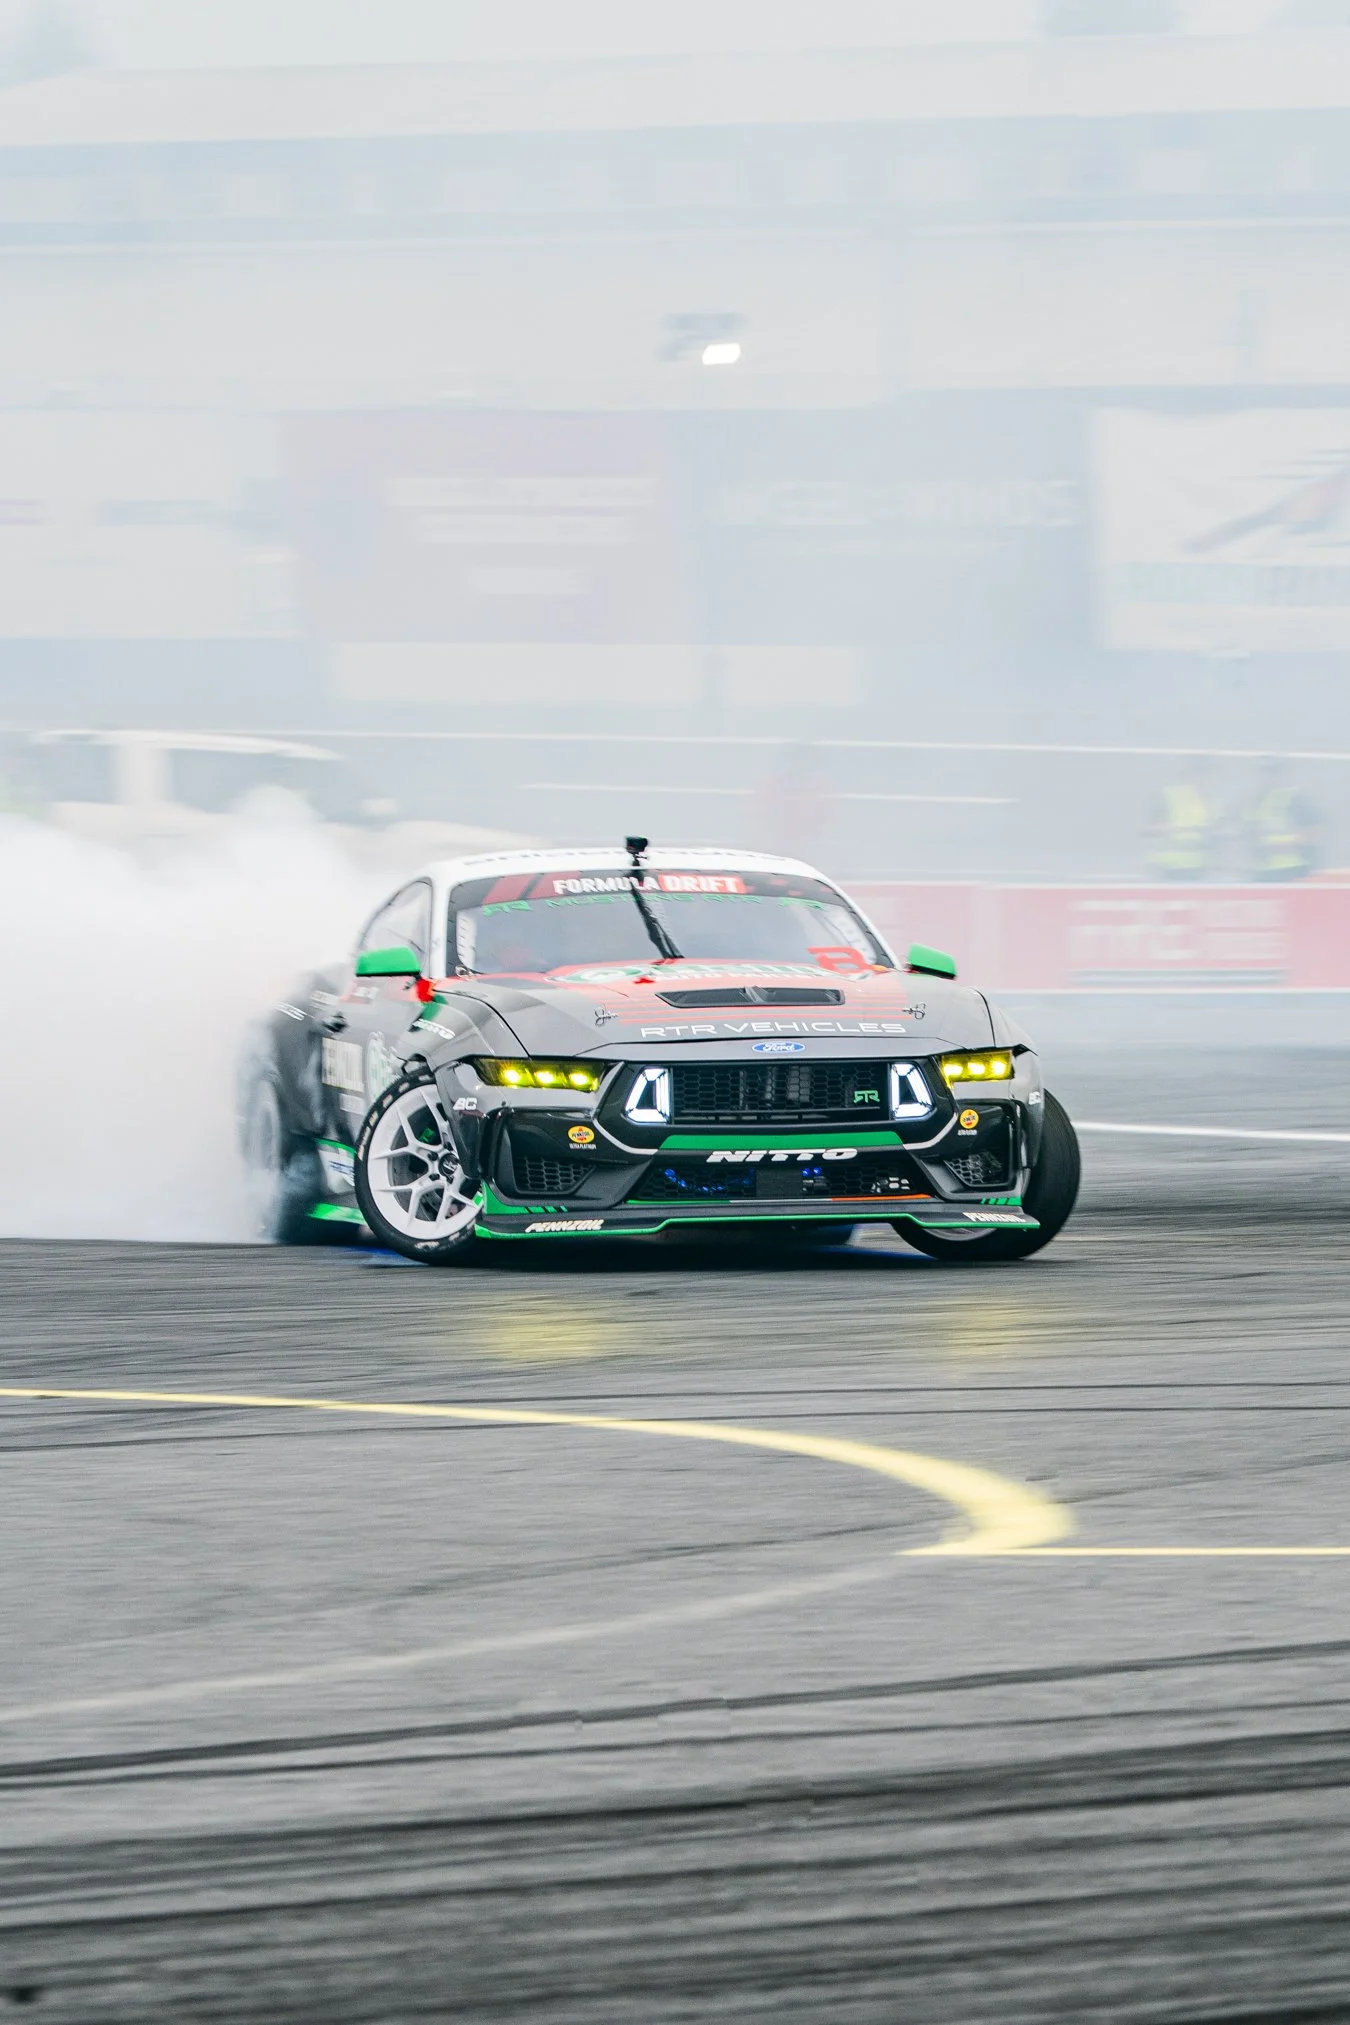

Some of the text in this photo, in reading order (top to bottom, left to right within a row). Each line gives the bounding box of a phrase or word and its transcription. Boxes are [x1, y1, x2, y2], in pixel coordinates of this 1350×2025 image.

[553, 875, 738, 894] FORMULA DRIFT
[640, 1022, 906, 1038] RTR VEHICLES
[762, 1041, 796, 1053] Ford
[706, 1148, 858, 1163] NITTO
[525, 1219, 604, 1233] PENNZOIL
